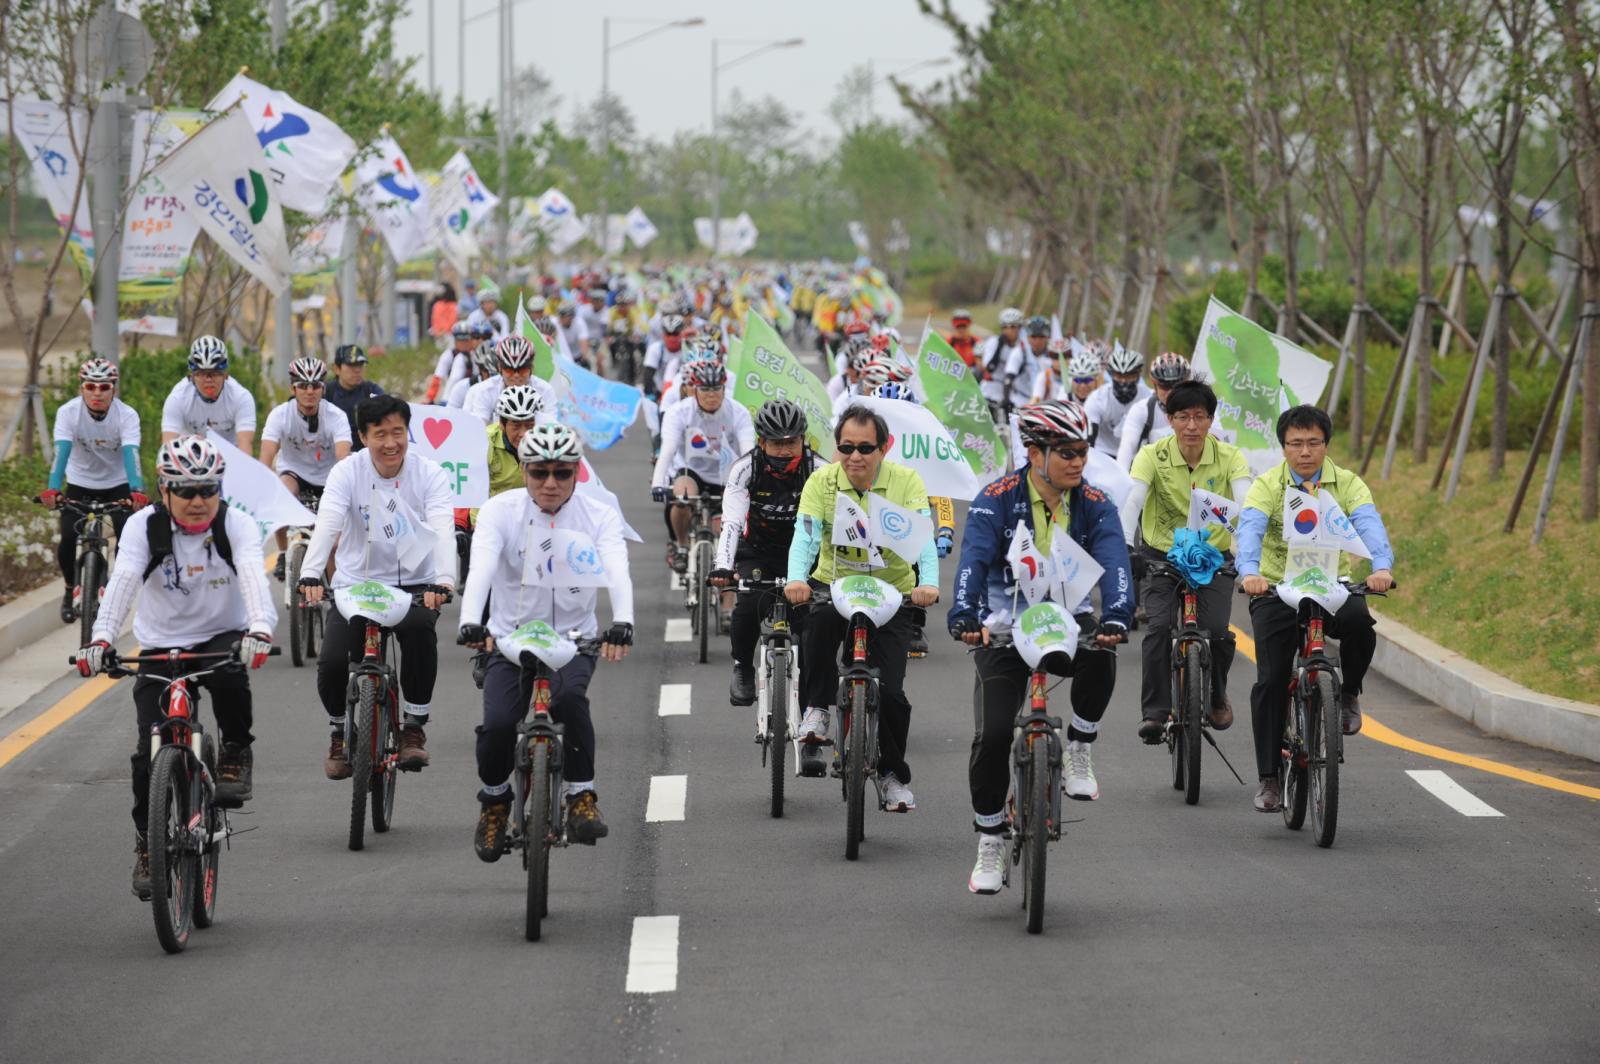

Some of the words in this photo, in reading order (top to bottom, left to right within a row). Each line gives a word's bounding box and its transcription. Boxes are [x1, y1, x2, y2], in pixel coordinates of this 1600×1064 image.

[753, 344, 786, 374] 환경
[926, 352, 966, 380] 제1회
[901, 433, 930, 460] UN
[961, 566, 972, 591] Tour
[1116, 567, 1126, 591] Korea
